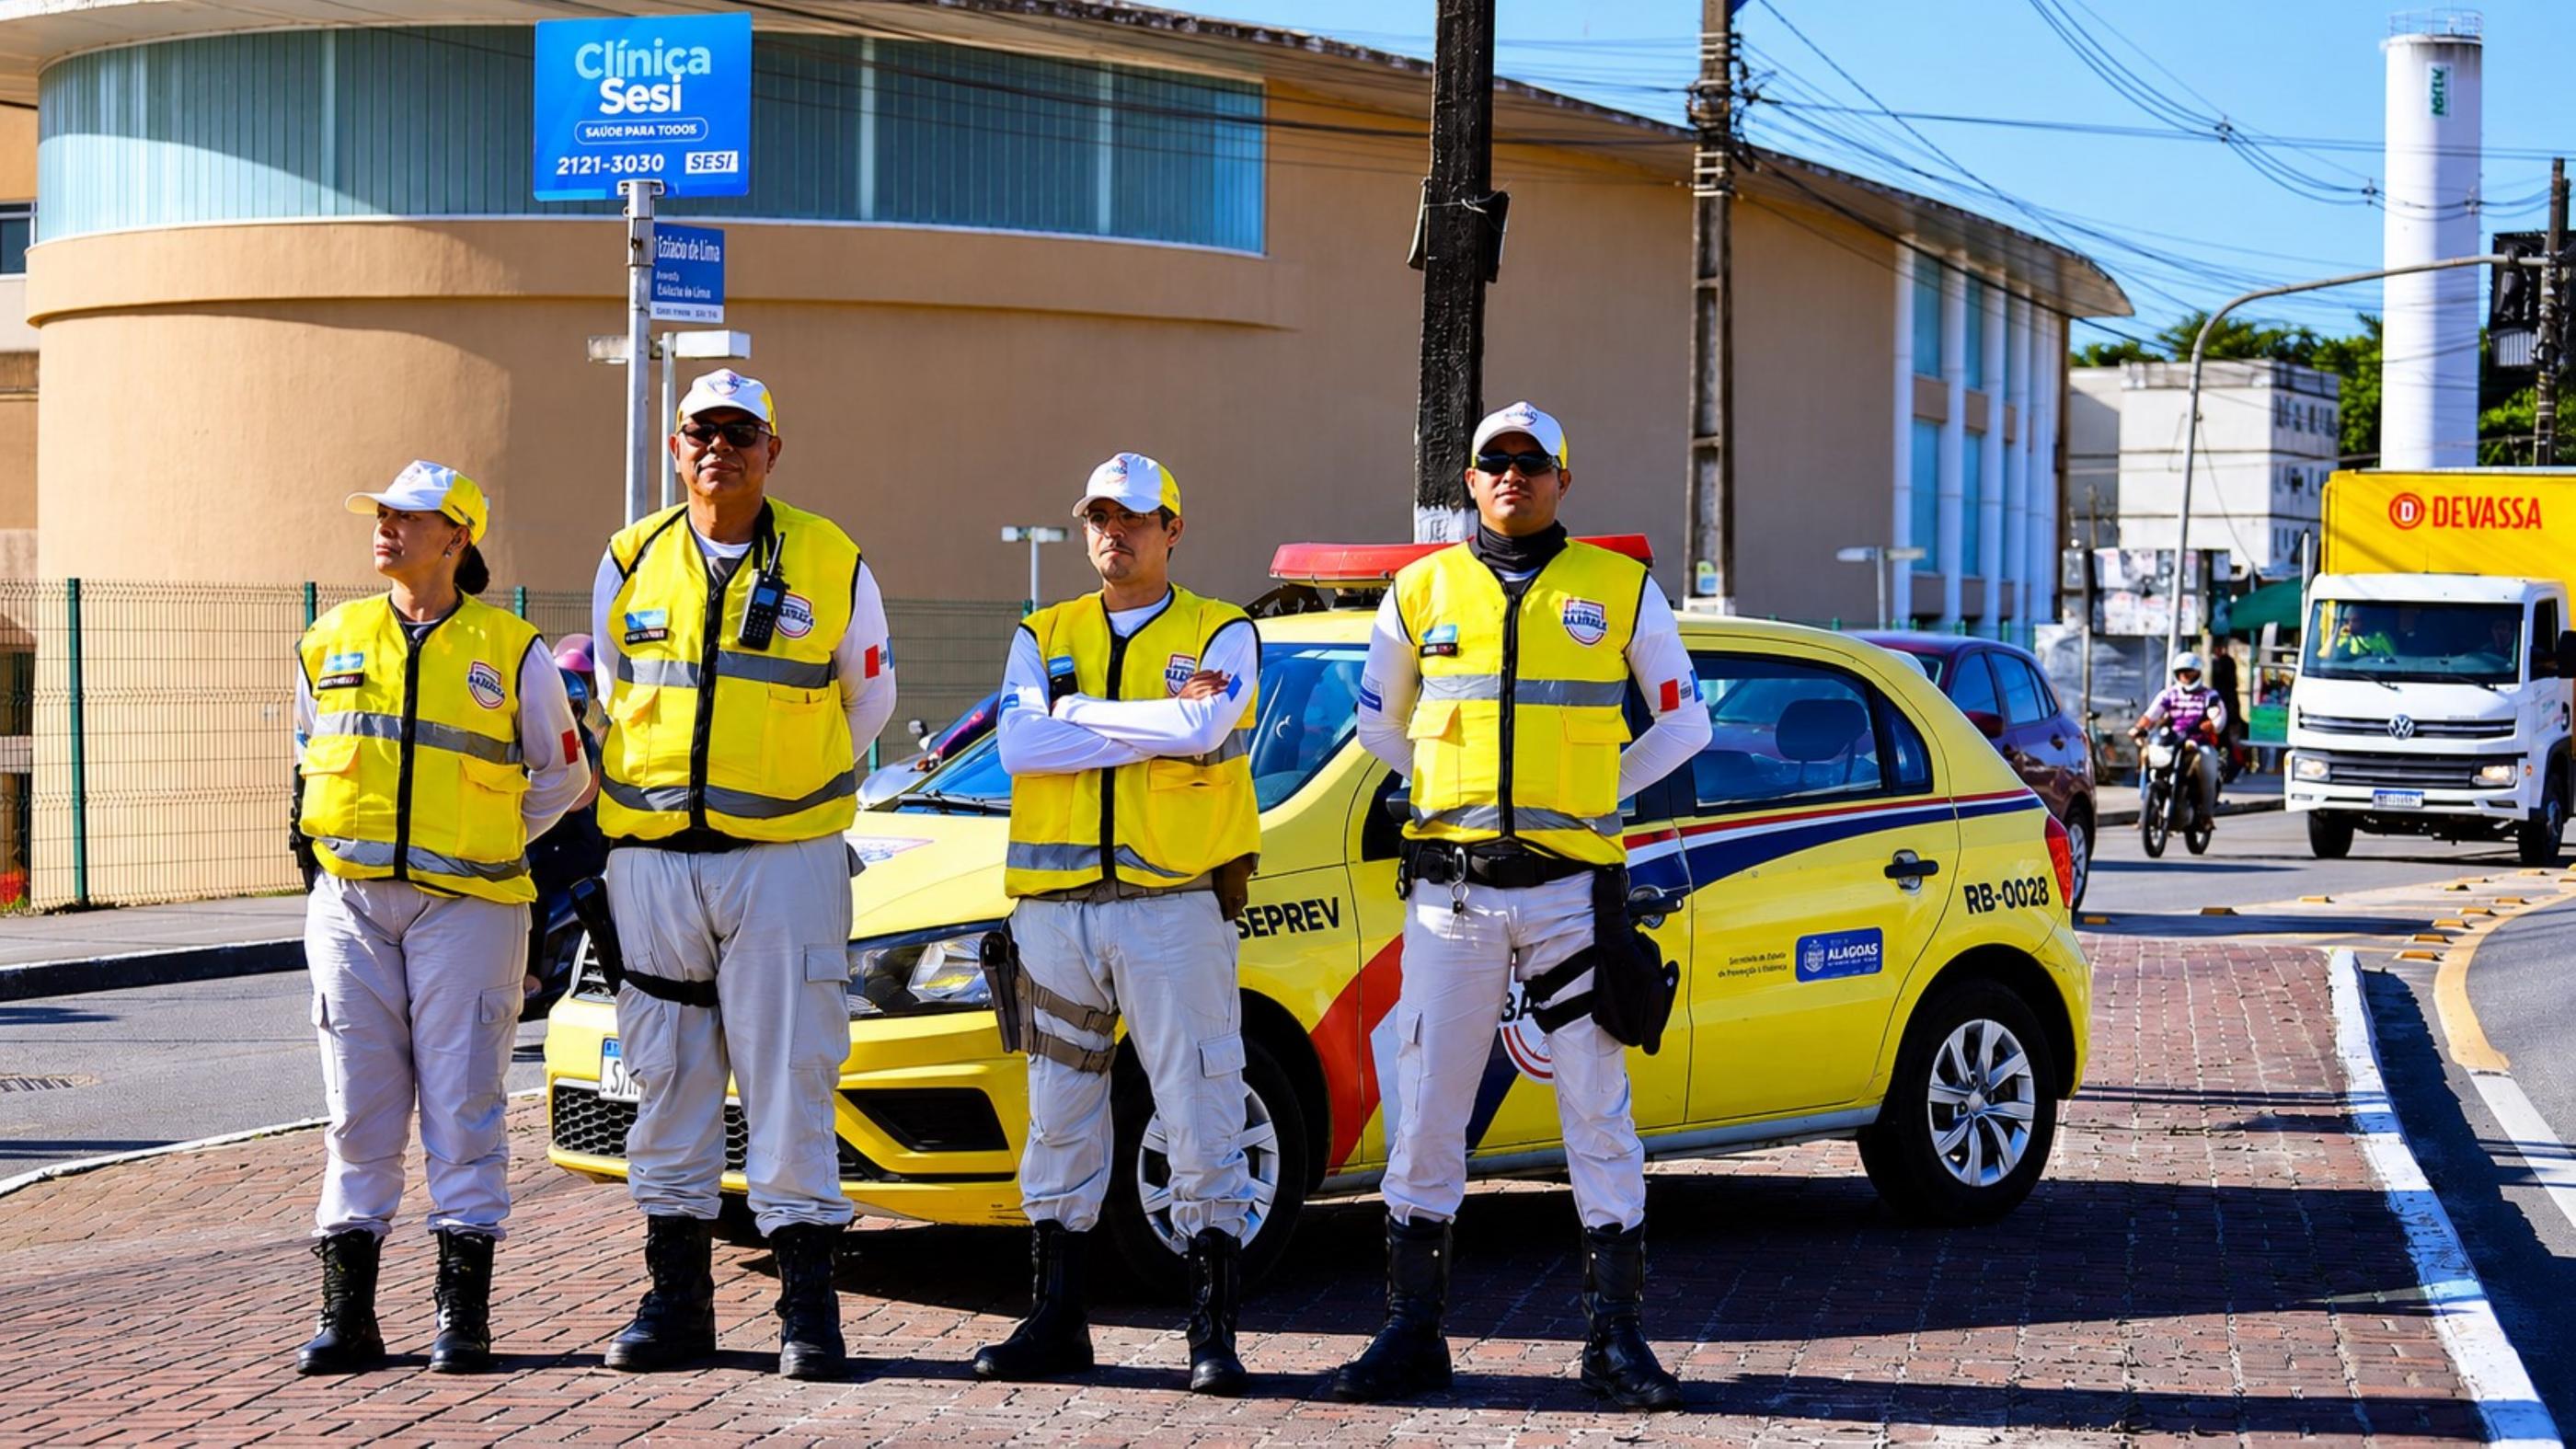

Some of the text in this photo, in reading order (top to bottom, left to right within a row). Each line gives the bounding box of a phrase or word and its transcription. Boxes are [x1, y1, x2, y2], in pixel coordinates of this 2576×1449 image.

[575, 38, 711, 79] Clínica
[599, 74, 682, 114] Sesi
[625, 125, 656, 137] PARA
[658, 123, 697, 136] TODOS
[556, 154, 732, 175] 2121-3030 SESI
[2432, 496, 2542, 530] DEVASSA
[1963, 876, 2049, 914] RB-0028
[1235, 896, 1340, 939] SEPREV
[1827, 942, 1879, 961] ALAGOAS
